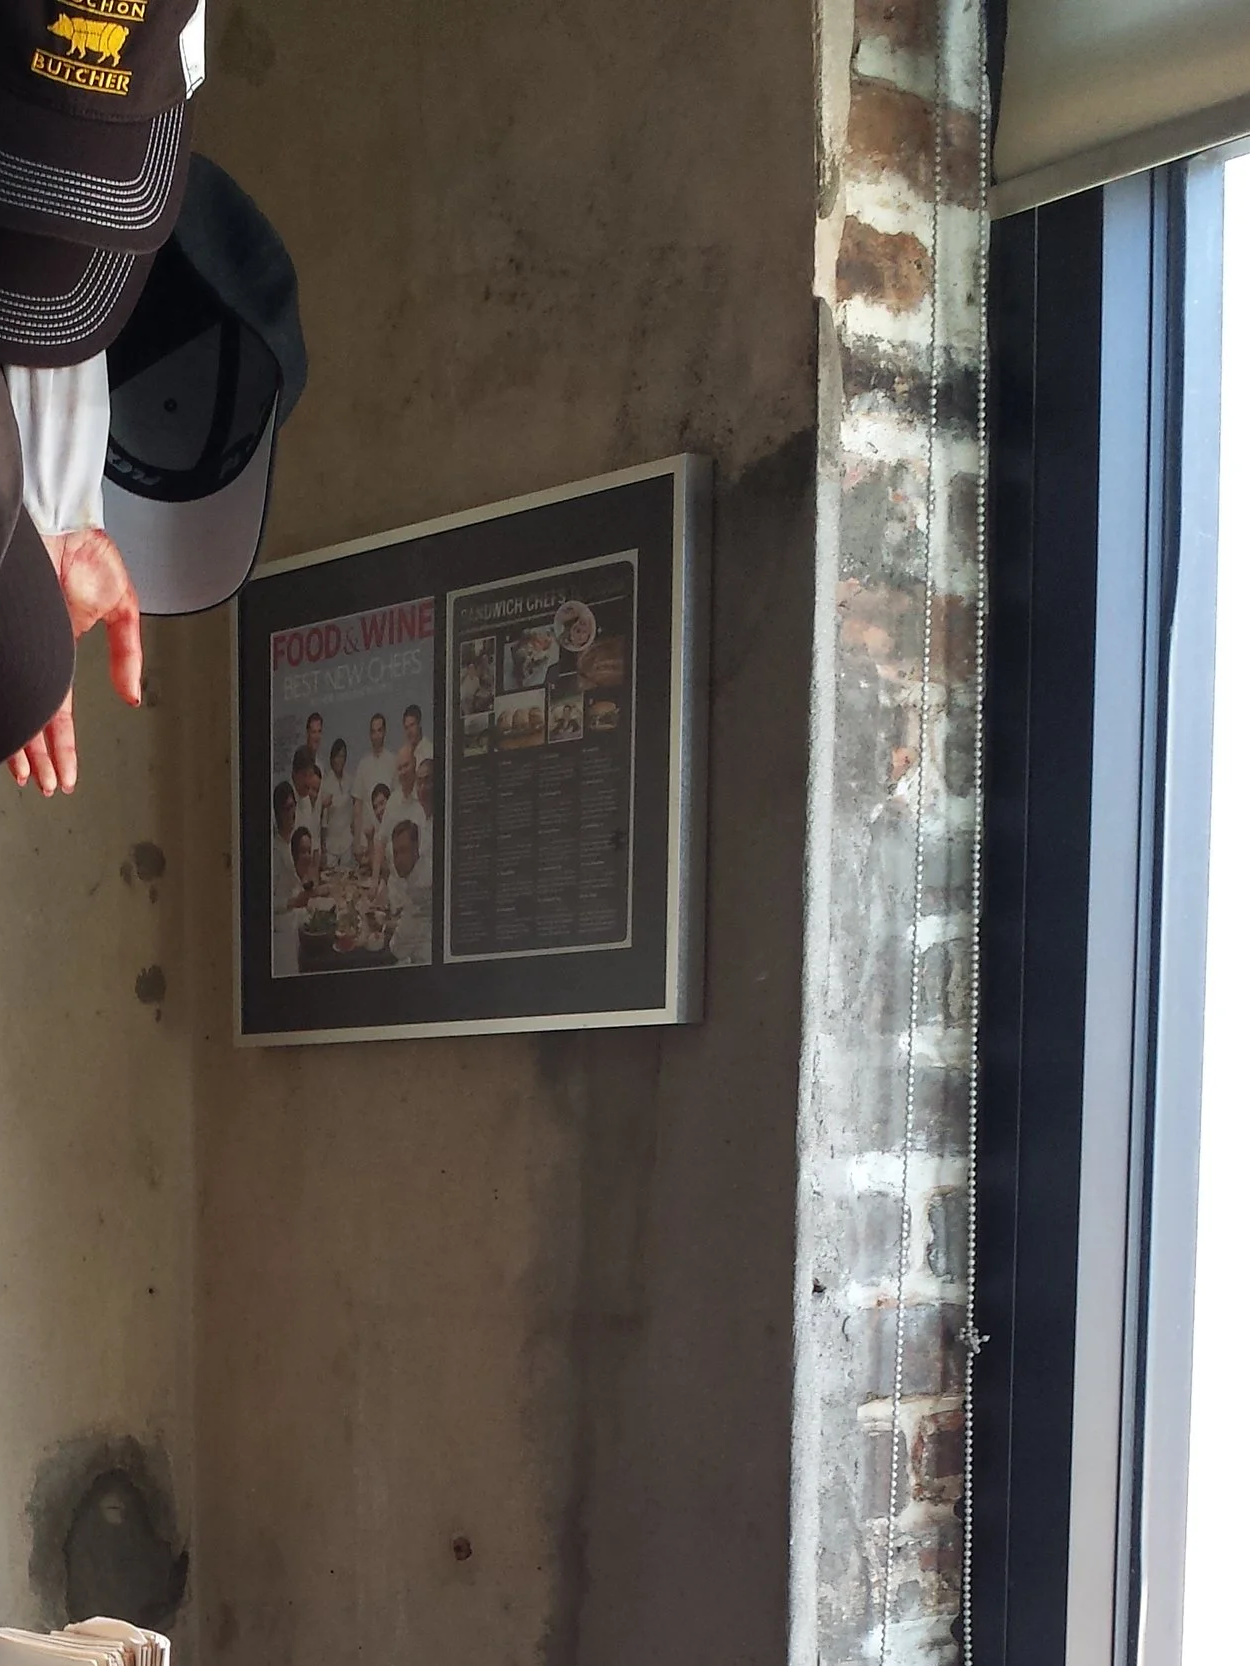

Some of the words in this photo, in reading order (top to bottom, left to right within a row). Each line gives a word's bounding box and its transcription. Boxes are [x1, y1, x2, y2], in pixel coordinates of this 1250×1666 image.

[75, 0, 146, 18] CHON
[32, 52, 131, 92] BUTCHER
[461, 598, 523, 622] SANDWICH
[273, 624, 342, 672] FOOD
[361, 602, 435, 650] WINE
[284, 670, 321, 702] BEST
[323, 660, 365, 691] NEW
[367, 649, 421, 683] CHEFS
